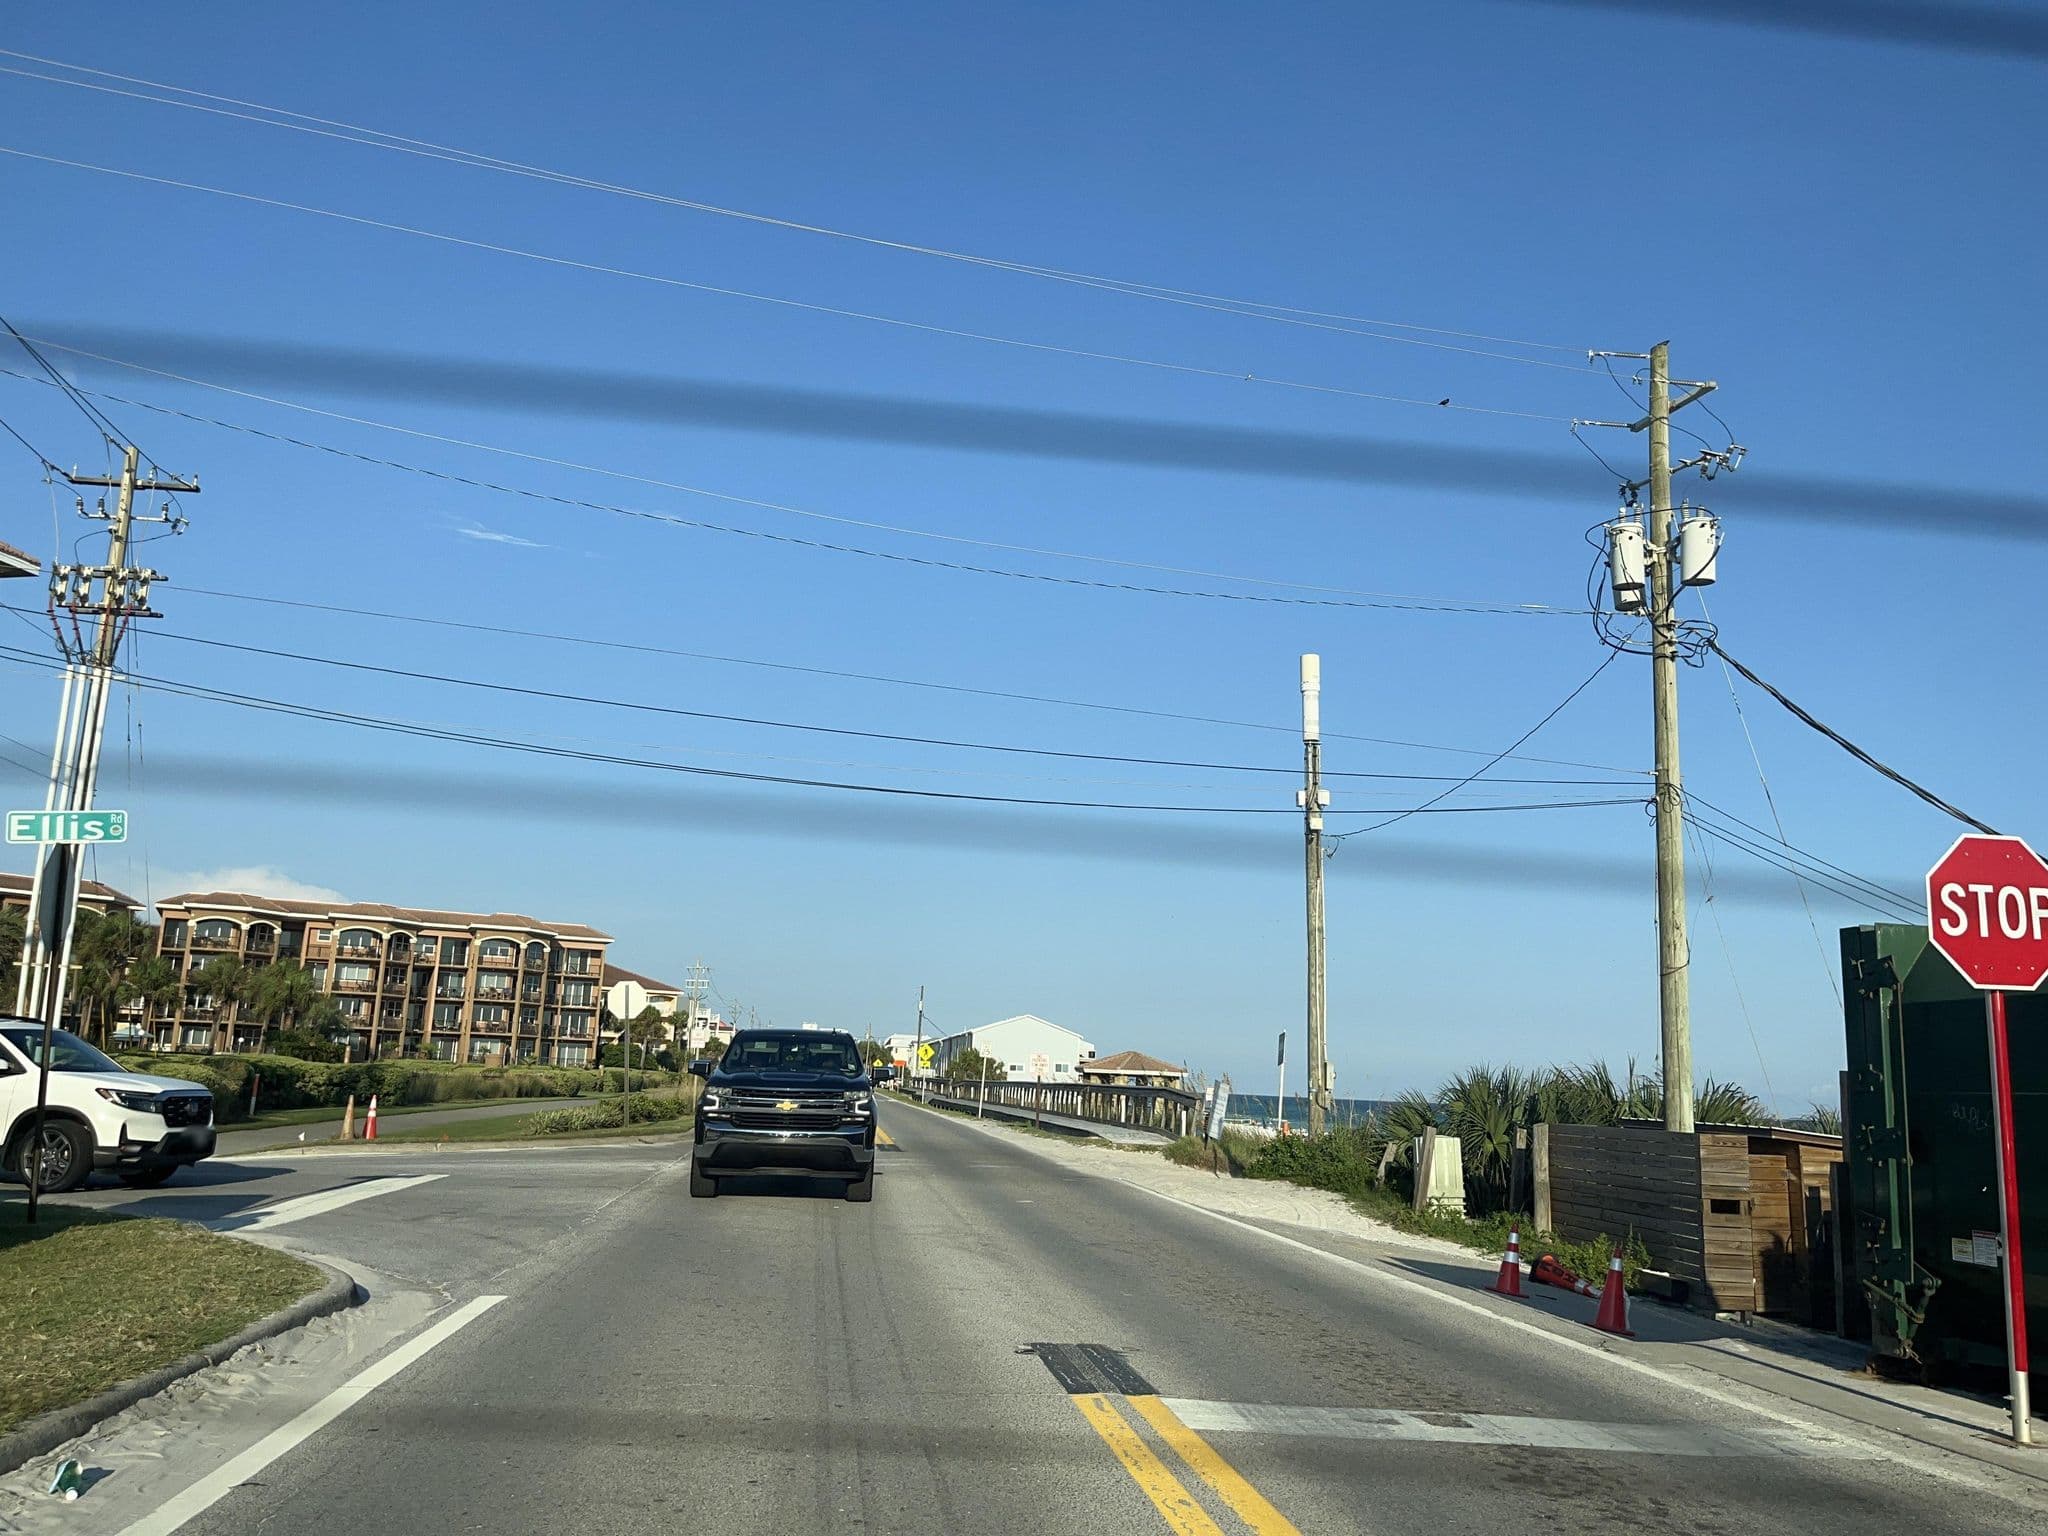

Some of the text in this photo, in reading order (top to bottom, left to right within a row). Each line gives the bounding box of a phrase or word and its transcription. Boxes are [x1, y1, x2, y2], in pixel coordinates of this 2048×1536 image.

[10, 814, 122, 840] Ellis Rd
[1939, 882, 2048, 940] STOP
